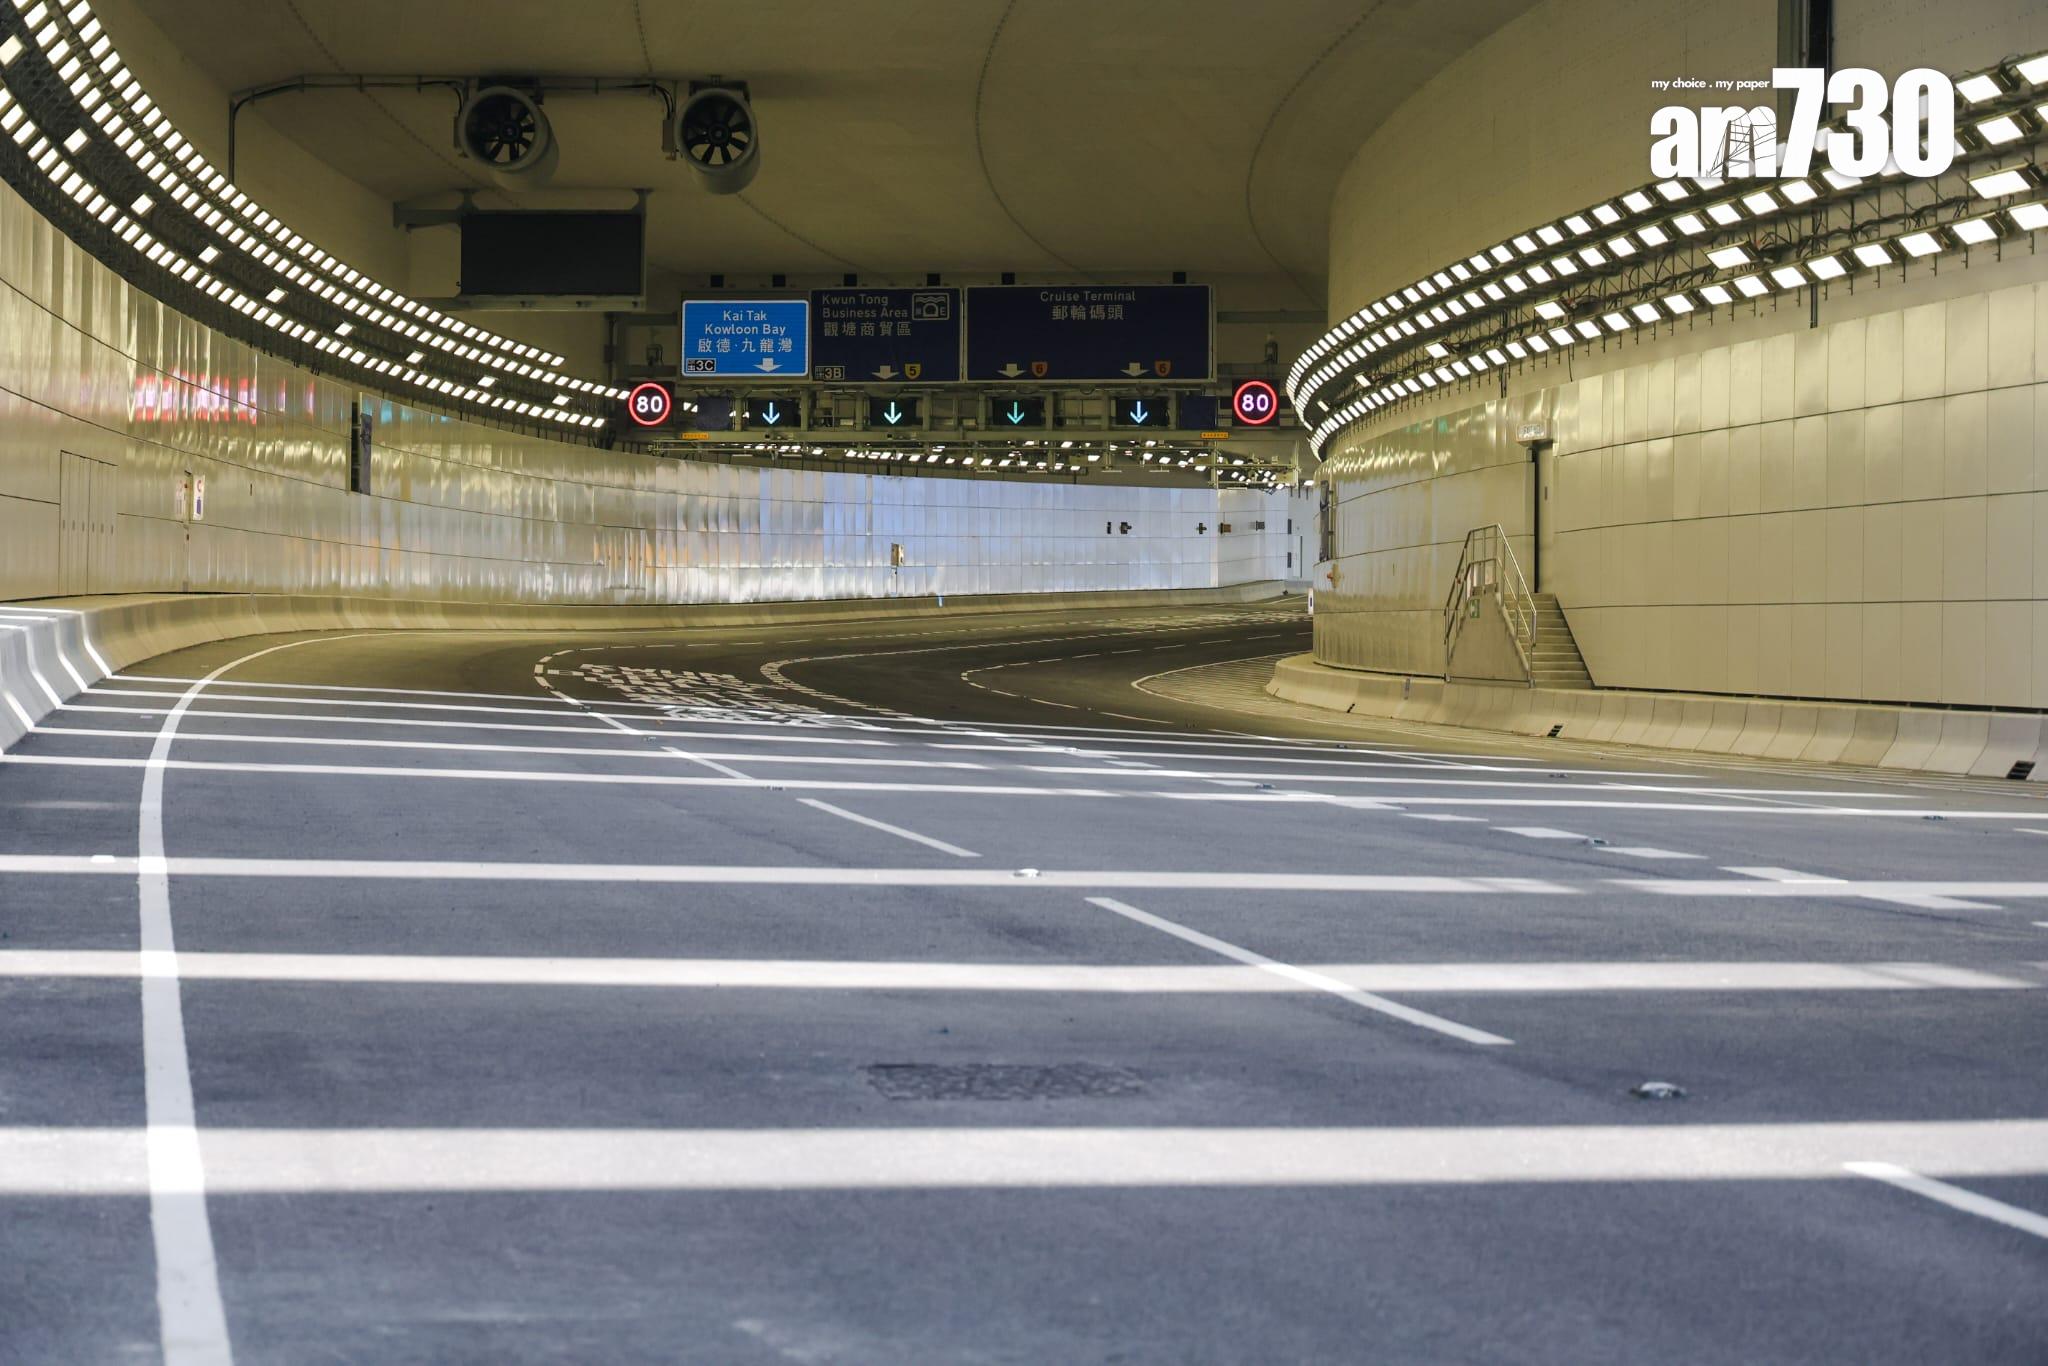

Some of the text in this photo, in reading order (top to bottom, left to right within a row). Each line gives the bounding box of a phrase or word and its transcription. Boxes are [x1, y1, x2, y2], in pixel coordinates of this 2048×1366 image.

[822, 294, 889, 307] Kwun Tong
[1040, 290, 1136, 302] Cruise Terminal
[722, 310, 768, 321] Kai Tak
[822, 307, 877, 319] Business
[880, 307, 909, 319] Area
[1051, 304, 1125, 321] 郵輪碼頭
[704, 324, 786, 337] Kowloon Bay
[823, 321, 912, 337] 觀塘商貿區
[695, 360, 714, 371] 3C
[909, 366, 917, 377] 5
[824, 367, 842, 379] 3B
[636, 396, 663, 413] 80
[1241, 394, 1269, 412] 80
